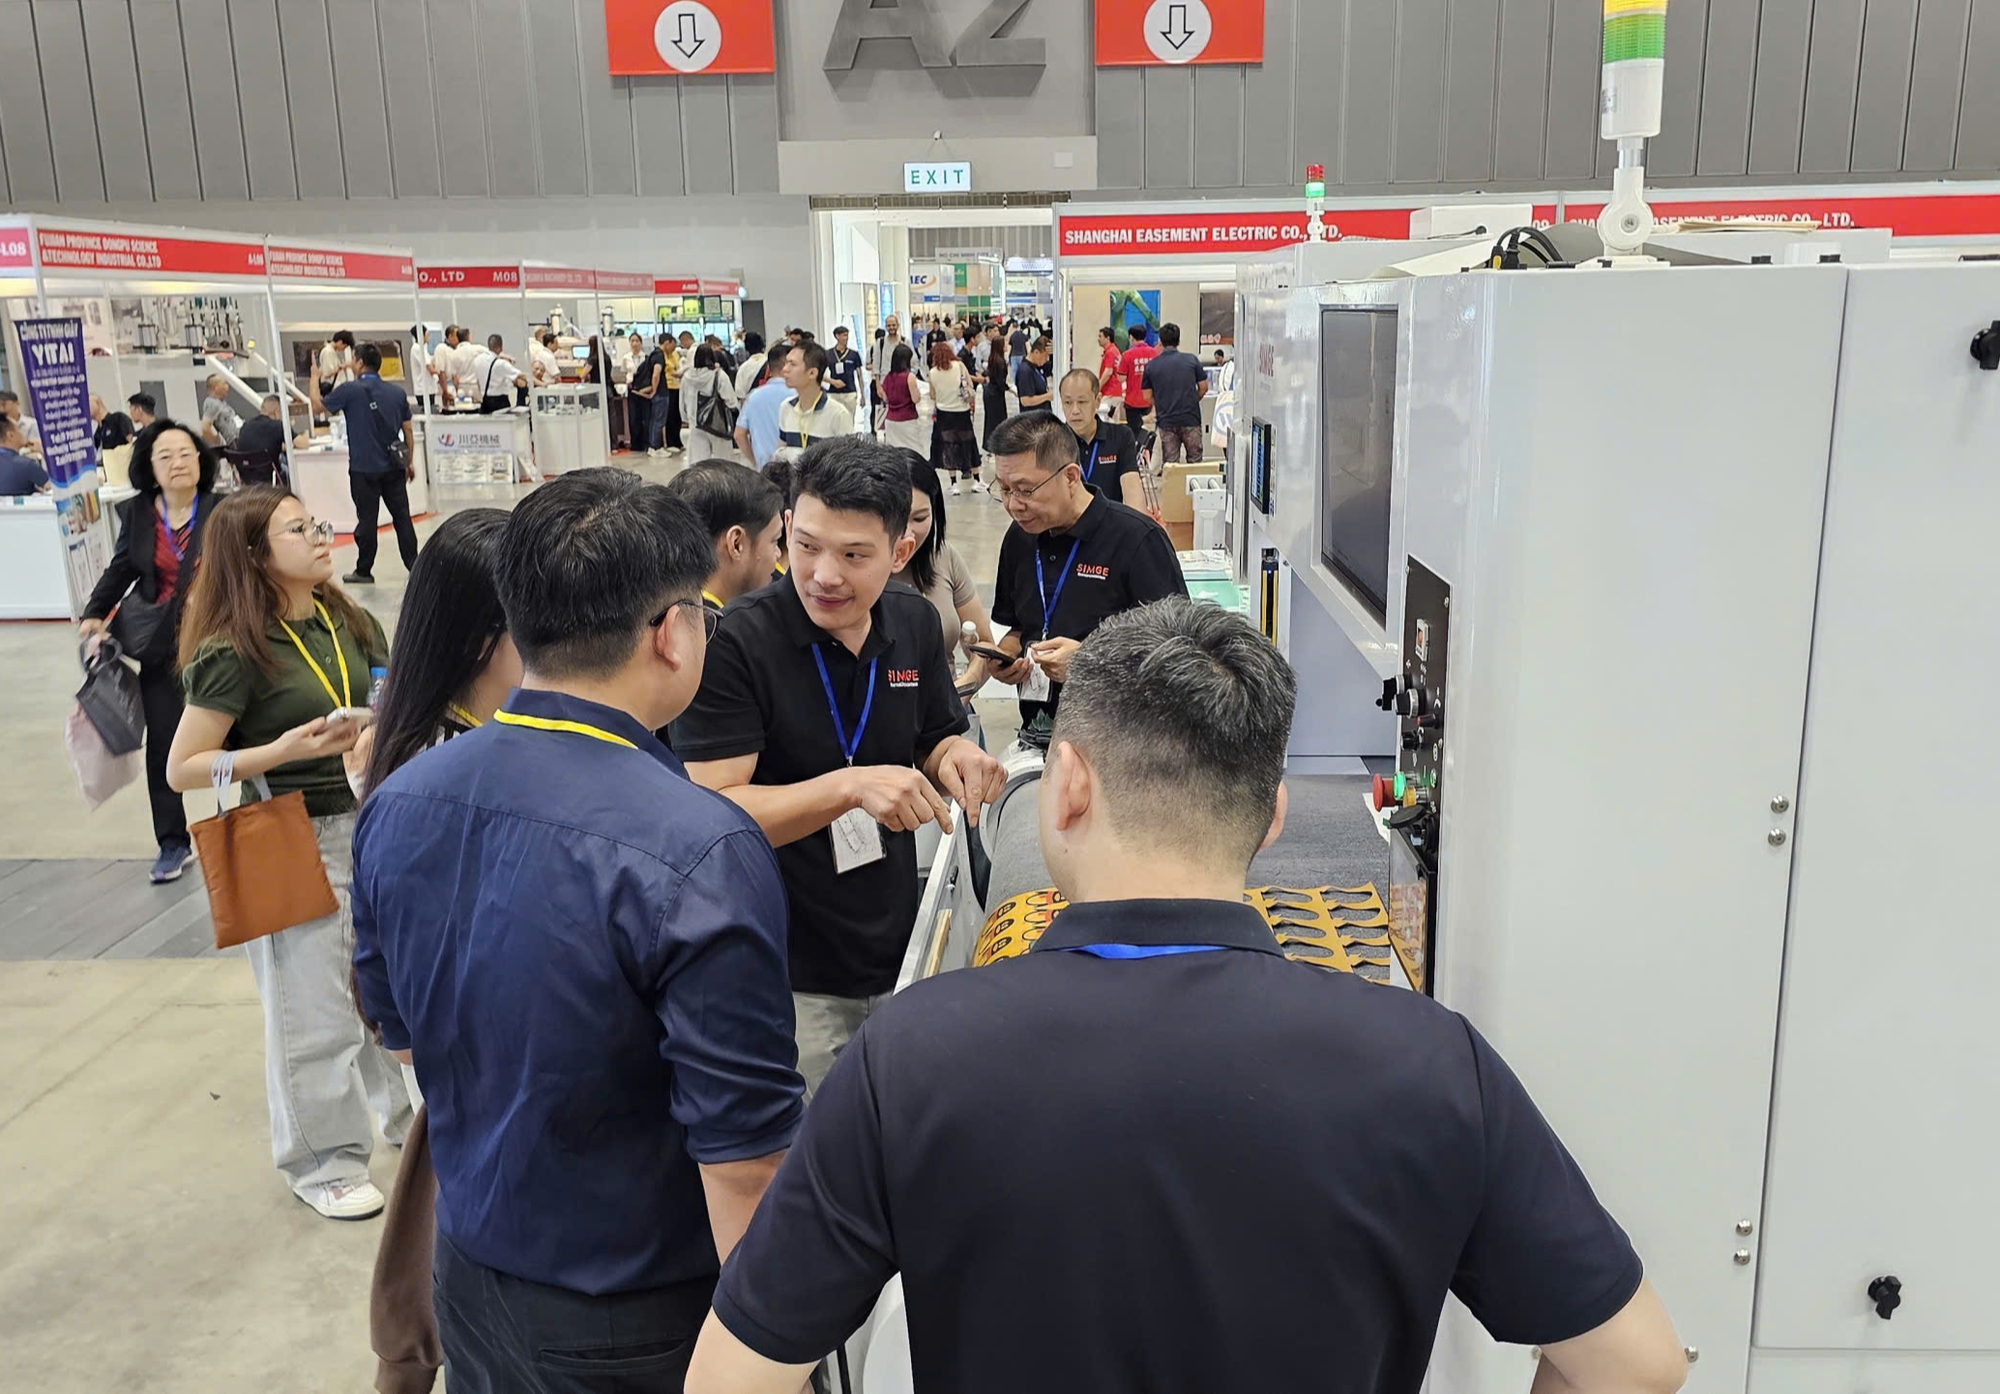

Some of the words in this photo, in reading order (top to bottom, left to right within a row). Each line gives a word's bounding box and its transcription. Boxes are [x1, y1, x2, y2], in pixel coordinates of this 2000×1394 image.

[911, 169, 964, 185] EXIT
[1823, 212, 1854, 227] LTD.
[1065, 229, 1132, 244] SHANGHAI
[1136, 228, 1208, 243] EASEMENT
[1212, 226, 1277, 240] ELECTRIC
[1281, 225, 1308, 240] CO.,
[1322, 225, 1343, 239] TD.
[66, 234, 102, 250] PROVINCE
[131, 239, 158, 254] SCIENCE
[418, 271, 437, 283] O.,
[441, 271, 465, 282] LTD
[493, 272, 518, 283] M08
[31, 341, 75, 366] YITAI
[1077, 563, 1109, 577] SIMGE
